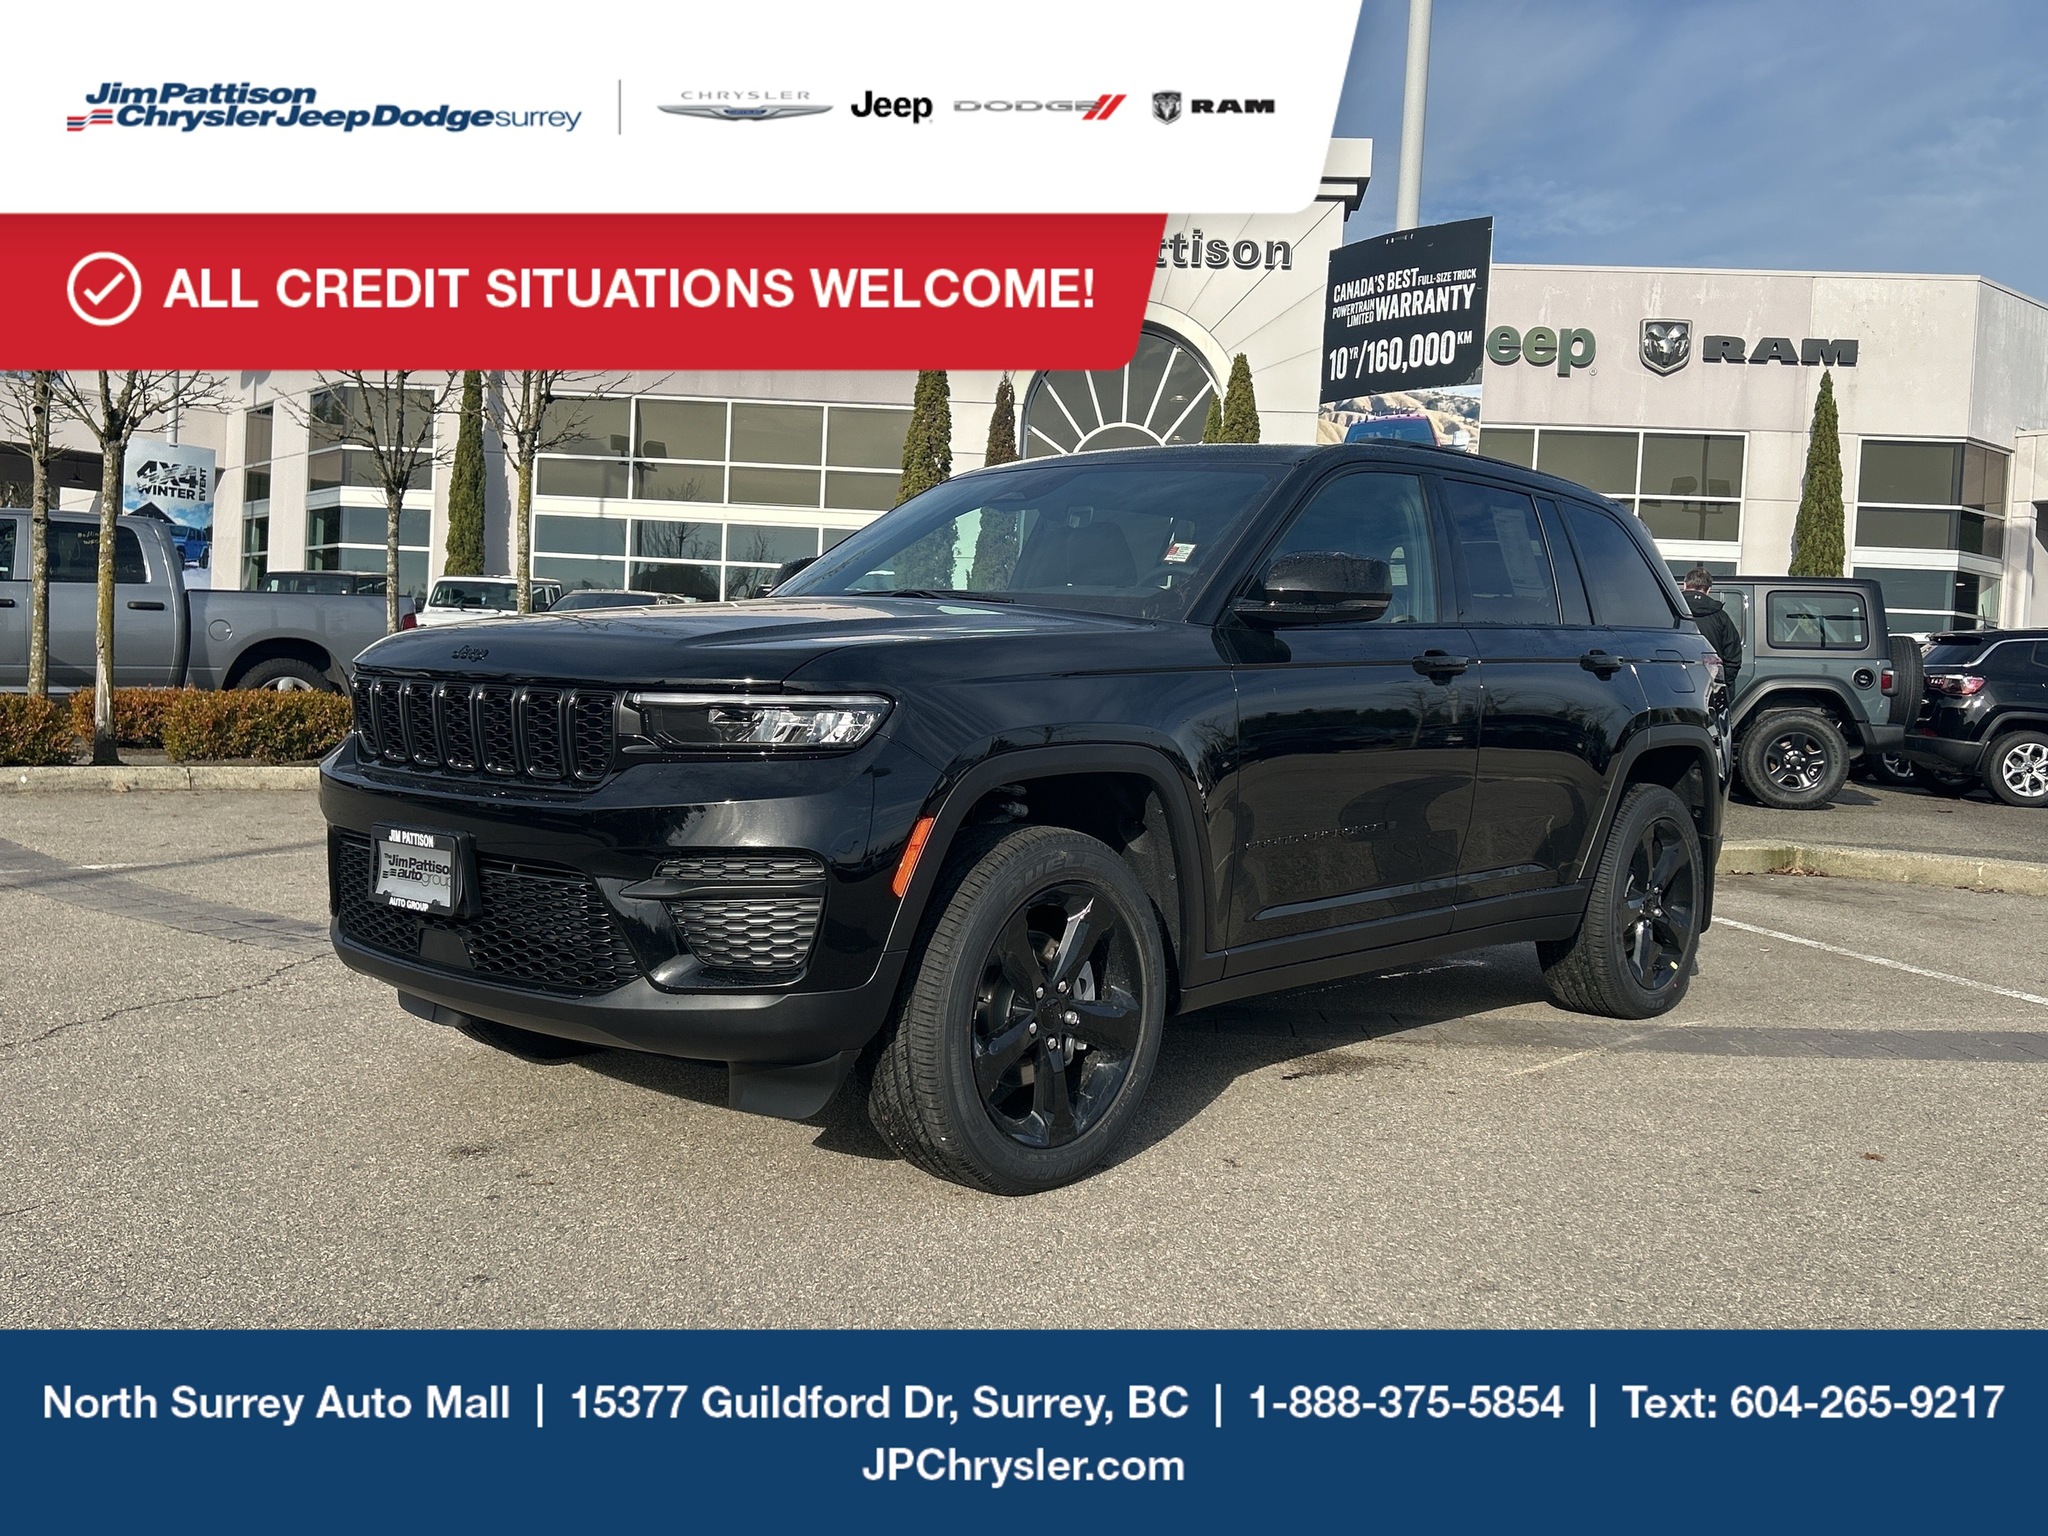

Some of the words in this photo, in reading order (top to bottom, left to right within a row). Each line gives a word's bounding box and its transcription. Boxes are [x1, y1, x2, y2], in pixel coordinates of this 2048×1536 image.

[1156, 228, 1293, 271] ttison
[1333, 273, 1385, 304] CANADA'S
[1386, 267, 1420, 292] BEST
[1417, 270, 1452, 286] FULL-SIZE
[1453, 267, 1478, 282] TRUCK
[1332, 298, 1375, 320] POWERTRAIN
[1375, 282, 1477, 323] WARRANTY
[1346, 310, 1375, 328] LIMITED
[1486, 325, 1597, 378] eep
[1702, 334, 1860, 367] RAM
[136, 482, 196, 501] WINTER
[198, 467, 208, 502] EVENT
[388, 829, 402, 843] JIM
[401, 830, 435, 848] PATTISON
[408, 857, 451, 876] Pattiso
[388, 896, 406, 908] AUTO
[406, 899, 429, 912] GROUP
